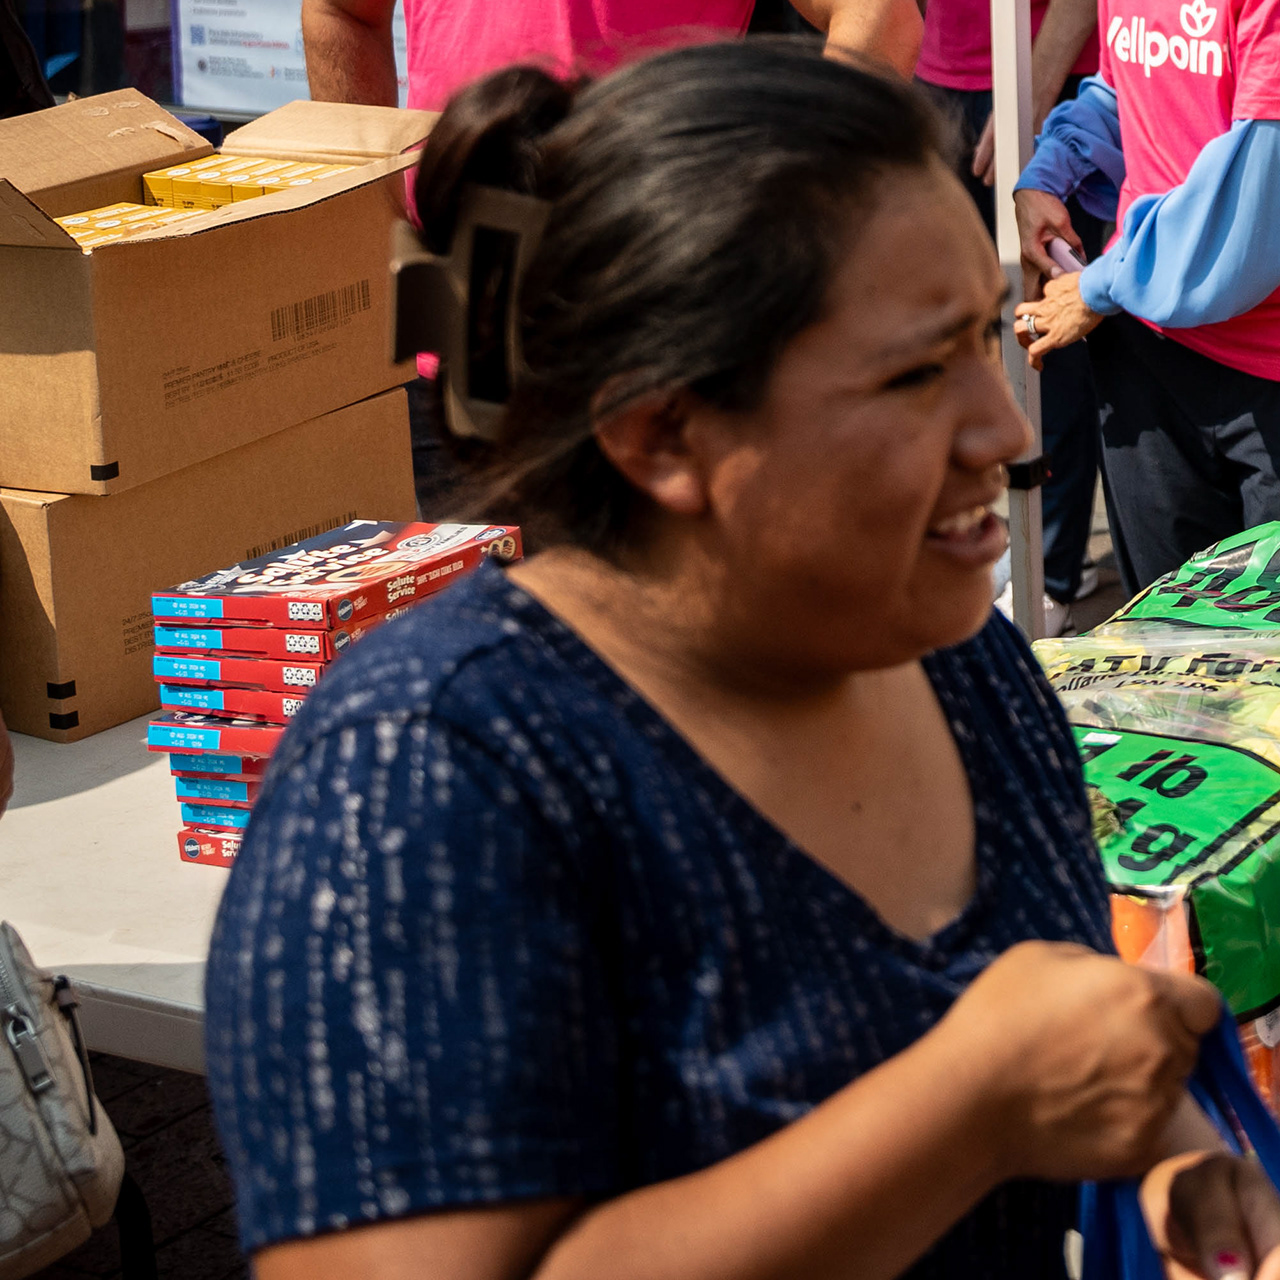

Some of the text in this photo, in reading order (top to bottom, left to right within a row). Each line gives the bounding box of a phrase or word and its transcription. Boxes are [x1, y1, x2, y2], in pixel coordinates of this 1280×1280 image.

[236, 543, 361, 587] Salute
[269, 546, 390, 587] Service
[386, 574, 416, 593] Salute
[387, 585, 416, 604] Service
[1115, 748, 1209, 799] lb
